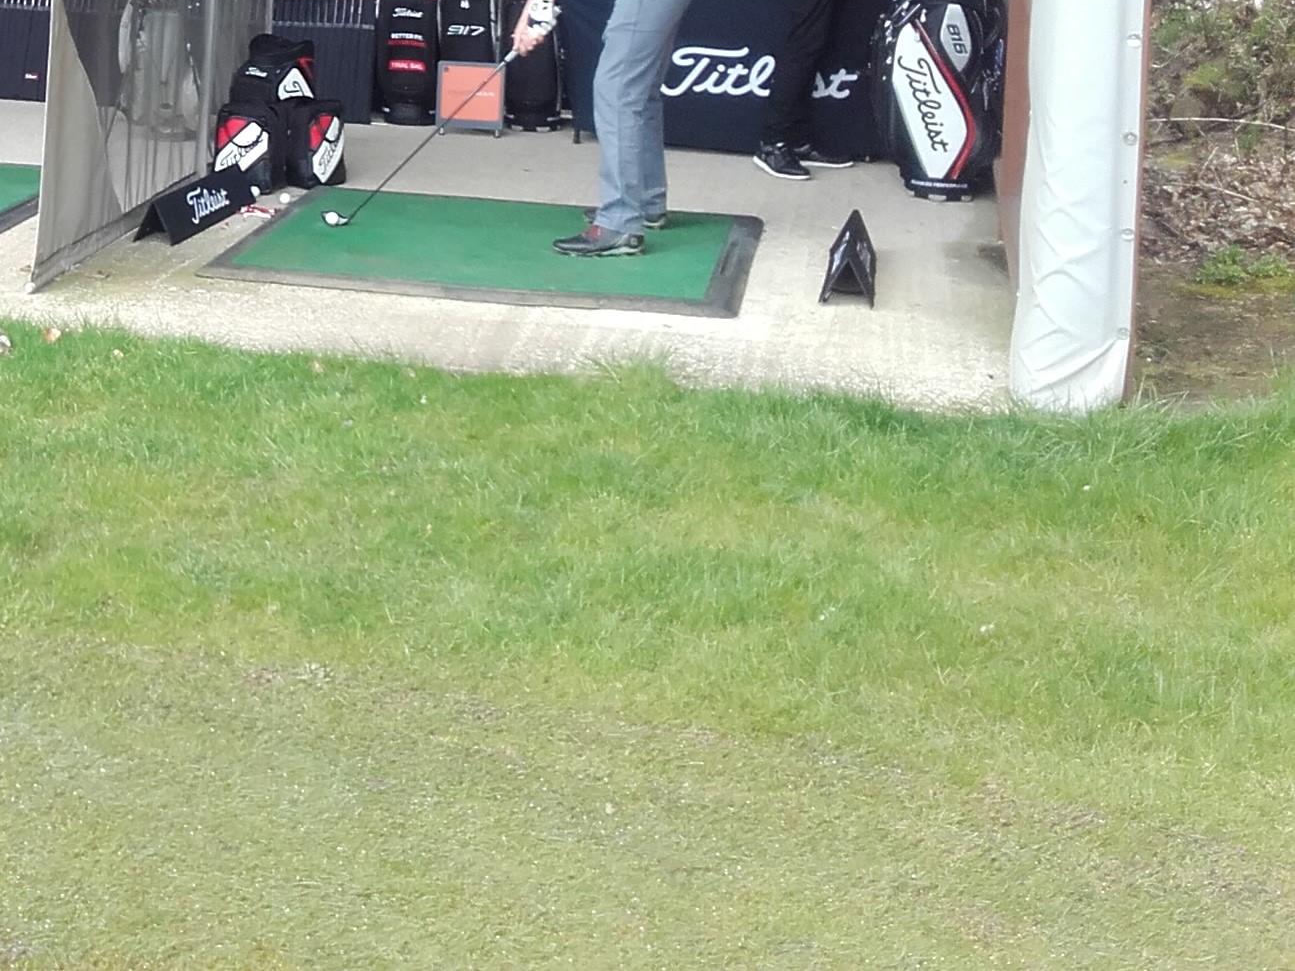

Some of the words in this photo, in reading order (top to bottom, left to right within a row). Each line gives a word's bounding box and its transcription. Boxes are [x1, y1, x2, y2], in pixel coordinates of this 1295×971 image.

[447, 25, 485, 36] 917
[659, 46, 859, 100] Titlst
[896, 55, 949, 154] Titleist
[186, 186, 230, 225] Titleist
